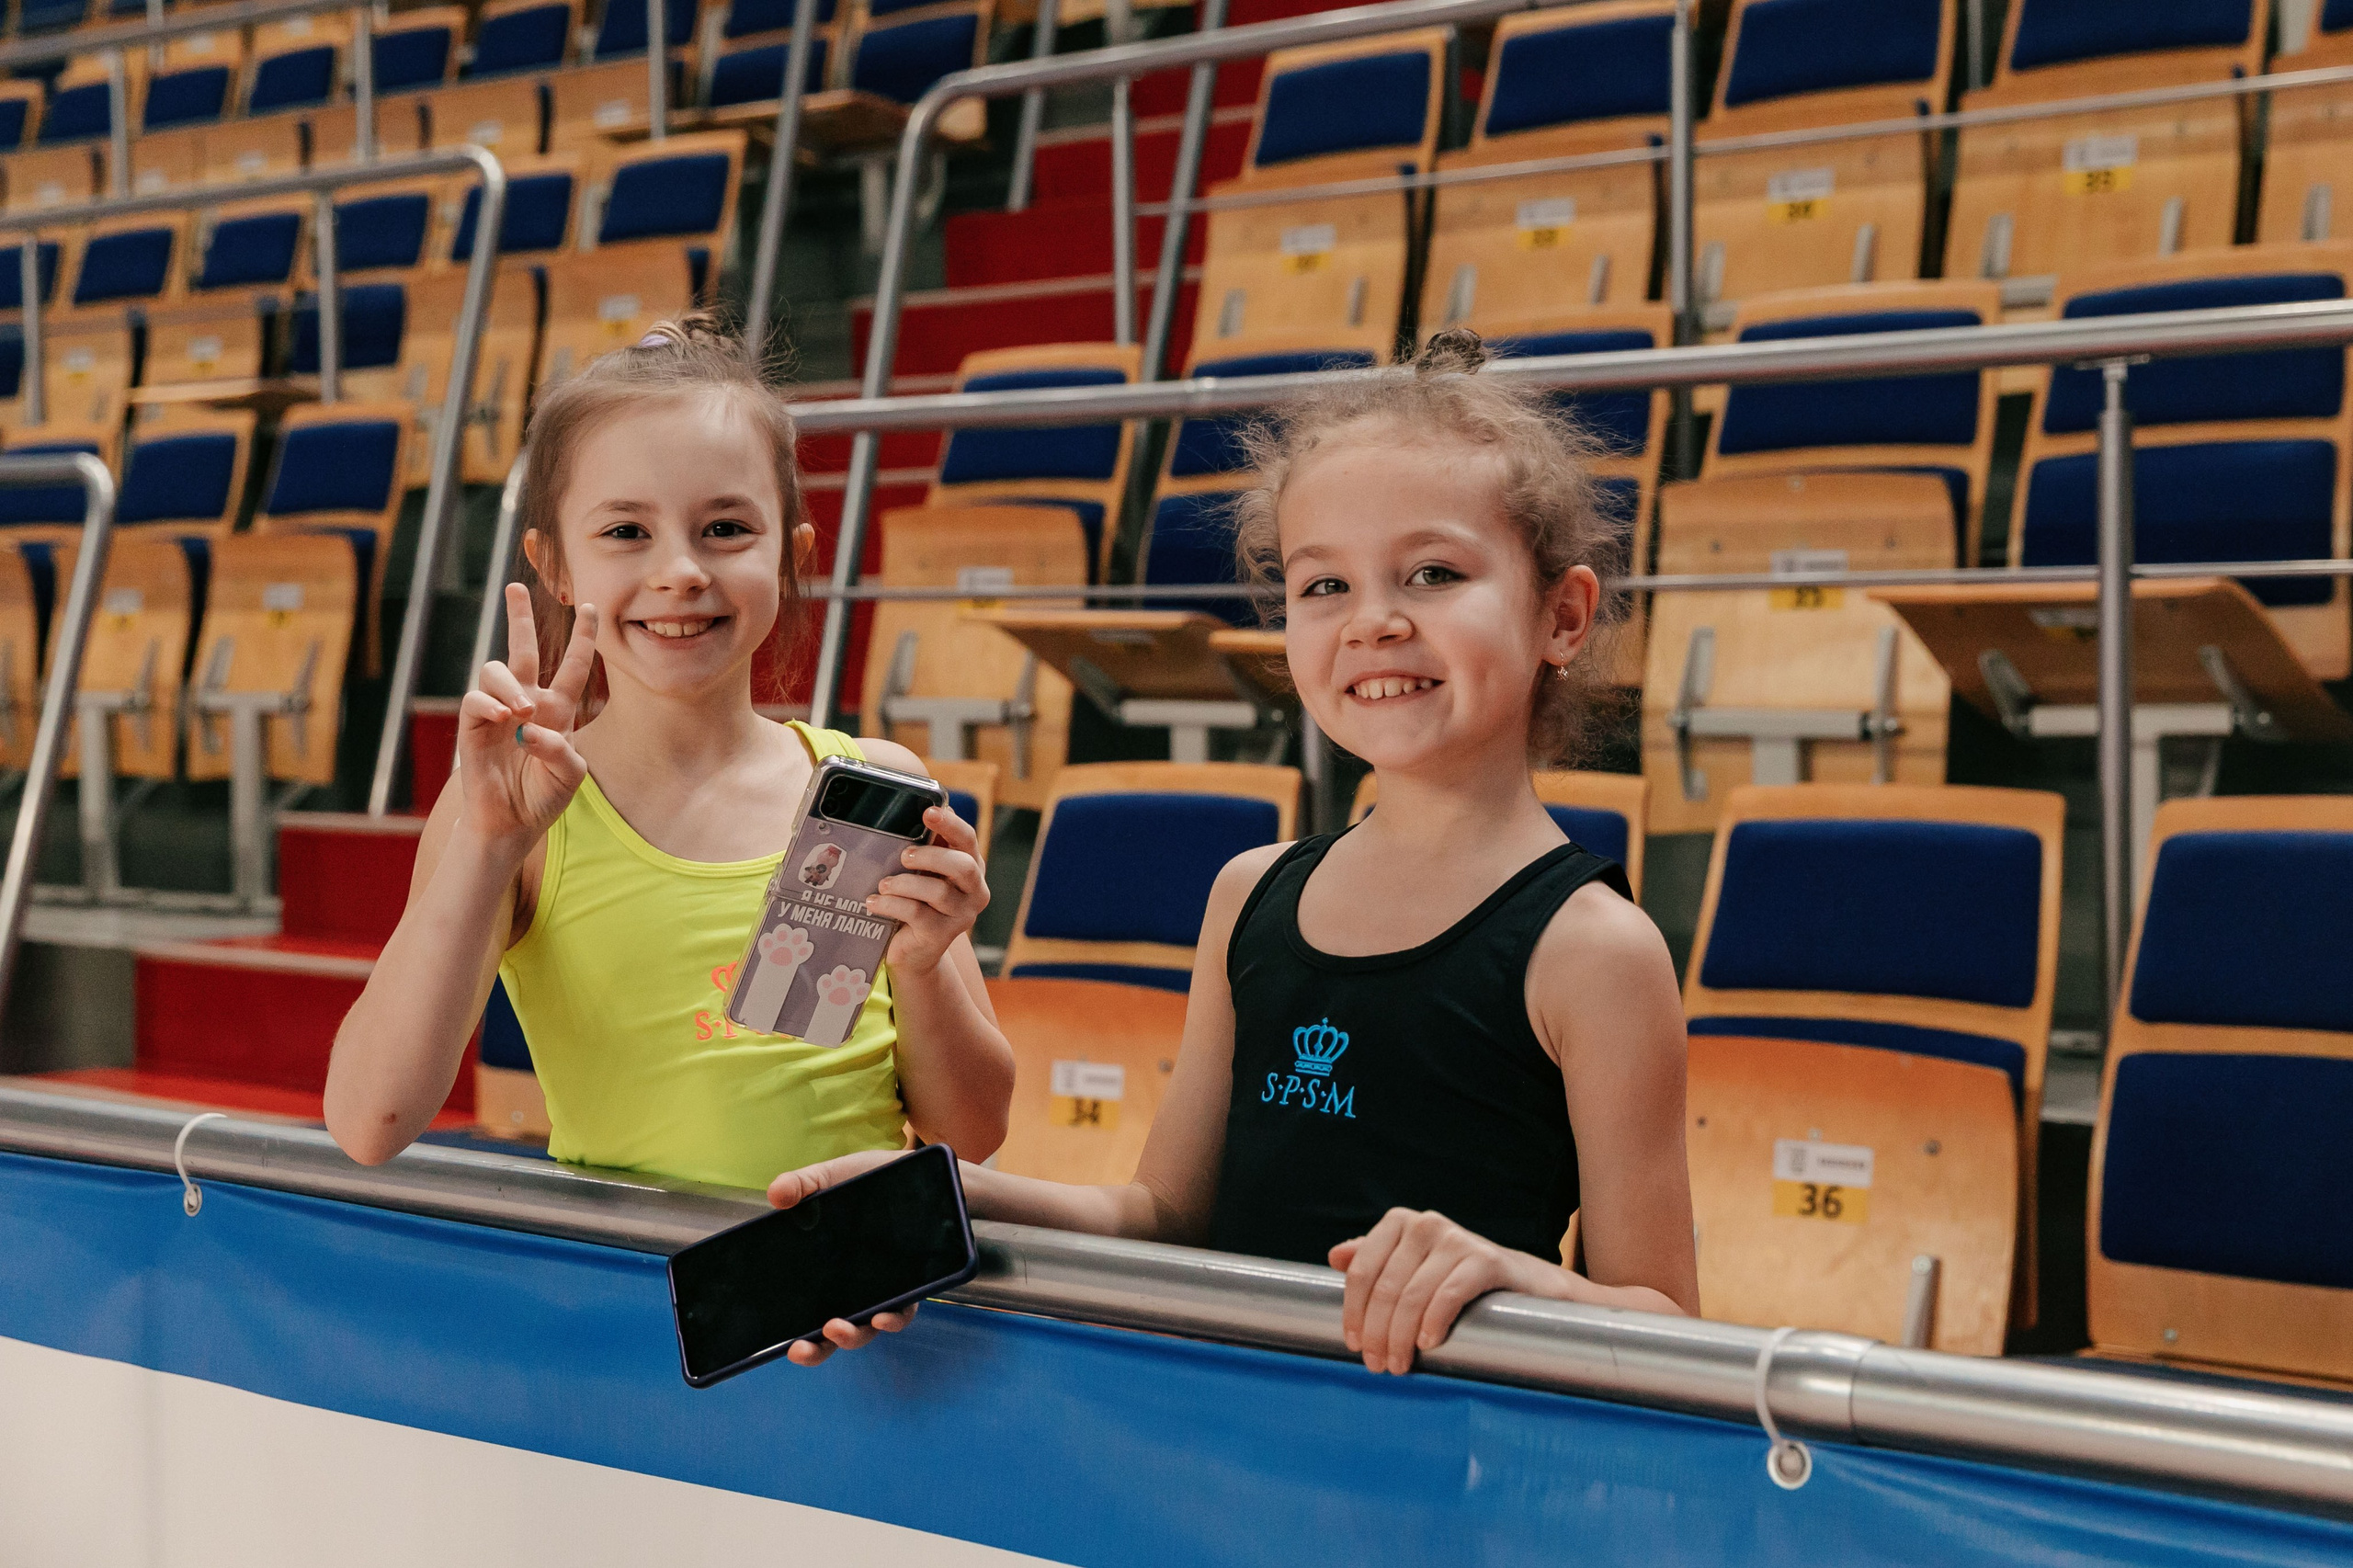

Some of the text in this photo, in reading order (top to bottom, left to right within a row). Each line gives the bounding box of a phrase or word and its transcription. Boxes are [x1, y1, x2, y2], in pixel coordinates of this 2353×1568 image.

[778, 901, 885, 940] У МЕНЯ ЛАПКИ
[1798, 1180, 1844, 1221] 36
